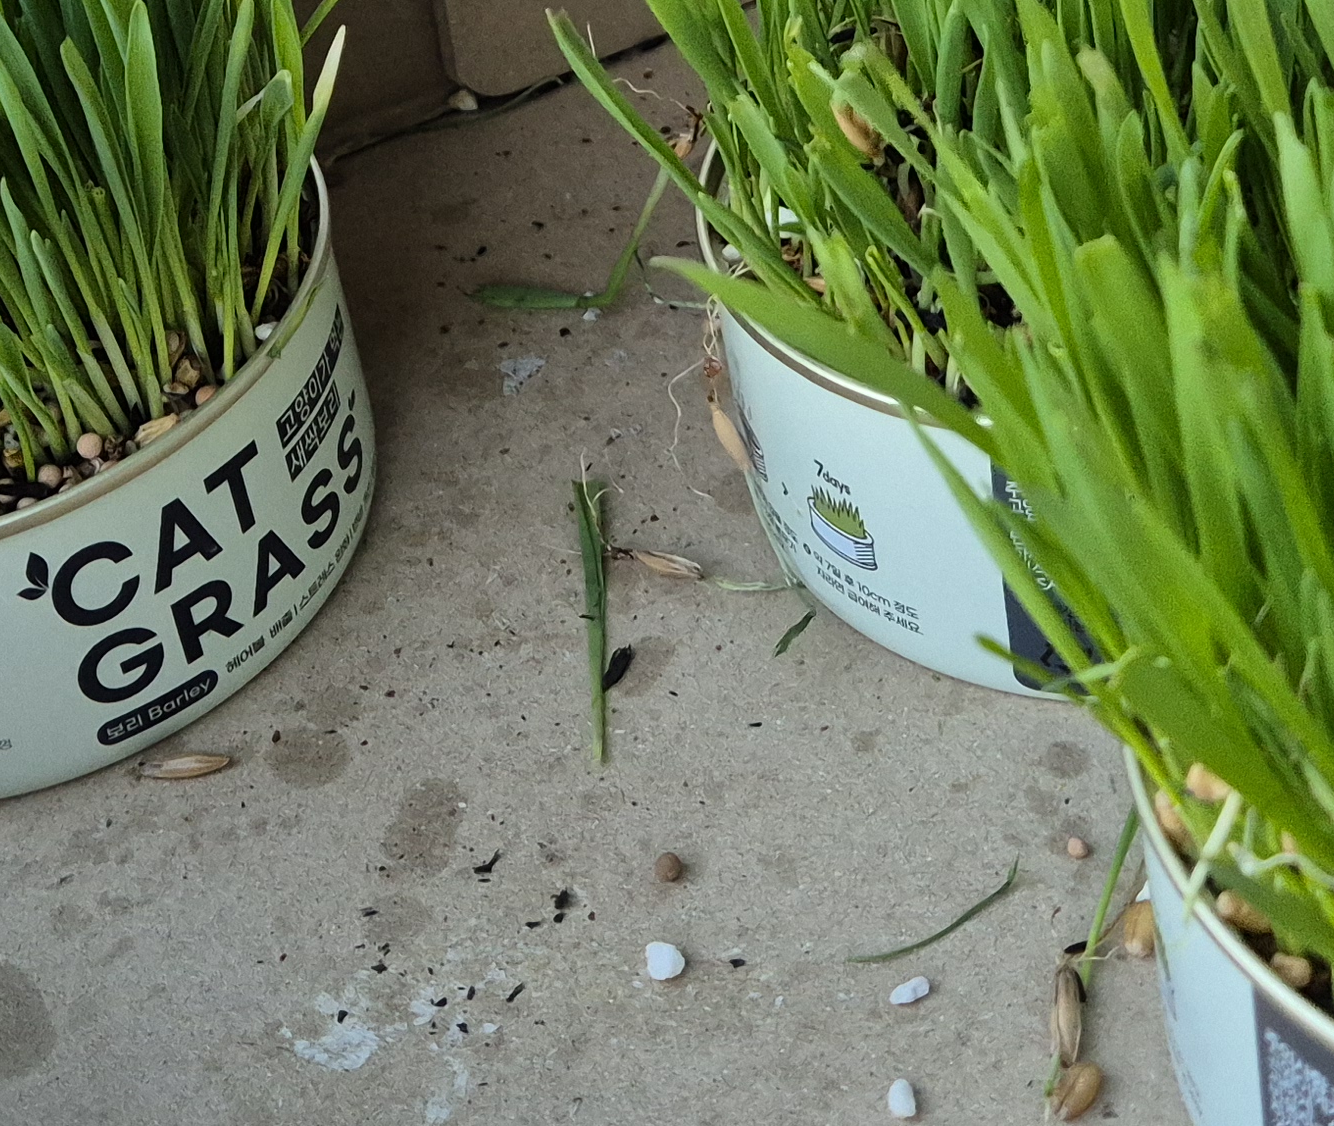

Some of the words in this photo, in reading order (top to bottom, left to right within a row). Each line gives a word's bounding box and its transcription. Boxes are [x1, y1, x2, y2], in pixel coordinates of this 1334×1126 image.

[280, 351, 332, 441] 고양이가
[290, 385, 341, 474] 새싹보리
[813, 459, 852, 495] 7days
[52, 439, 259, 627] CAT
[78, 414, 363, 703] GRASS
[225, 635, 266, 674] 헤어볼
[299, 561, 336, 611] 스트레스
[857, 581, 891, 607] 10cm
[894, 600, 919, 620] 정도
[883, 609, 924, 636] 주세요
[107, 713, 143, 741] 보리
[148, 677, 211, 721] Barley
